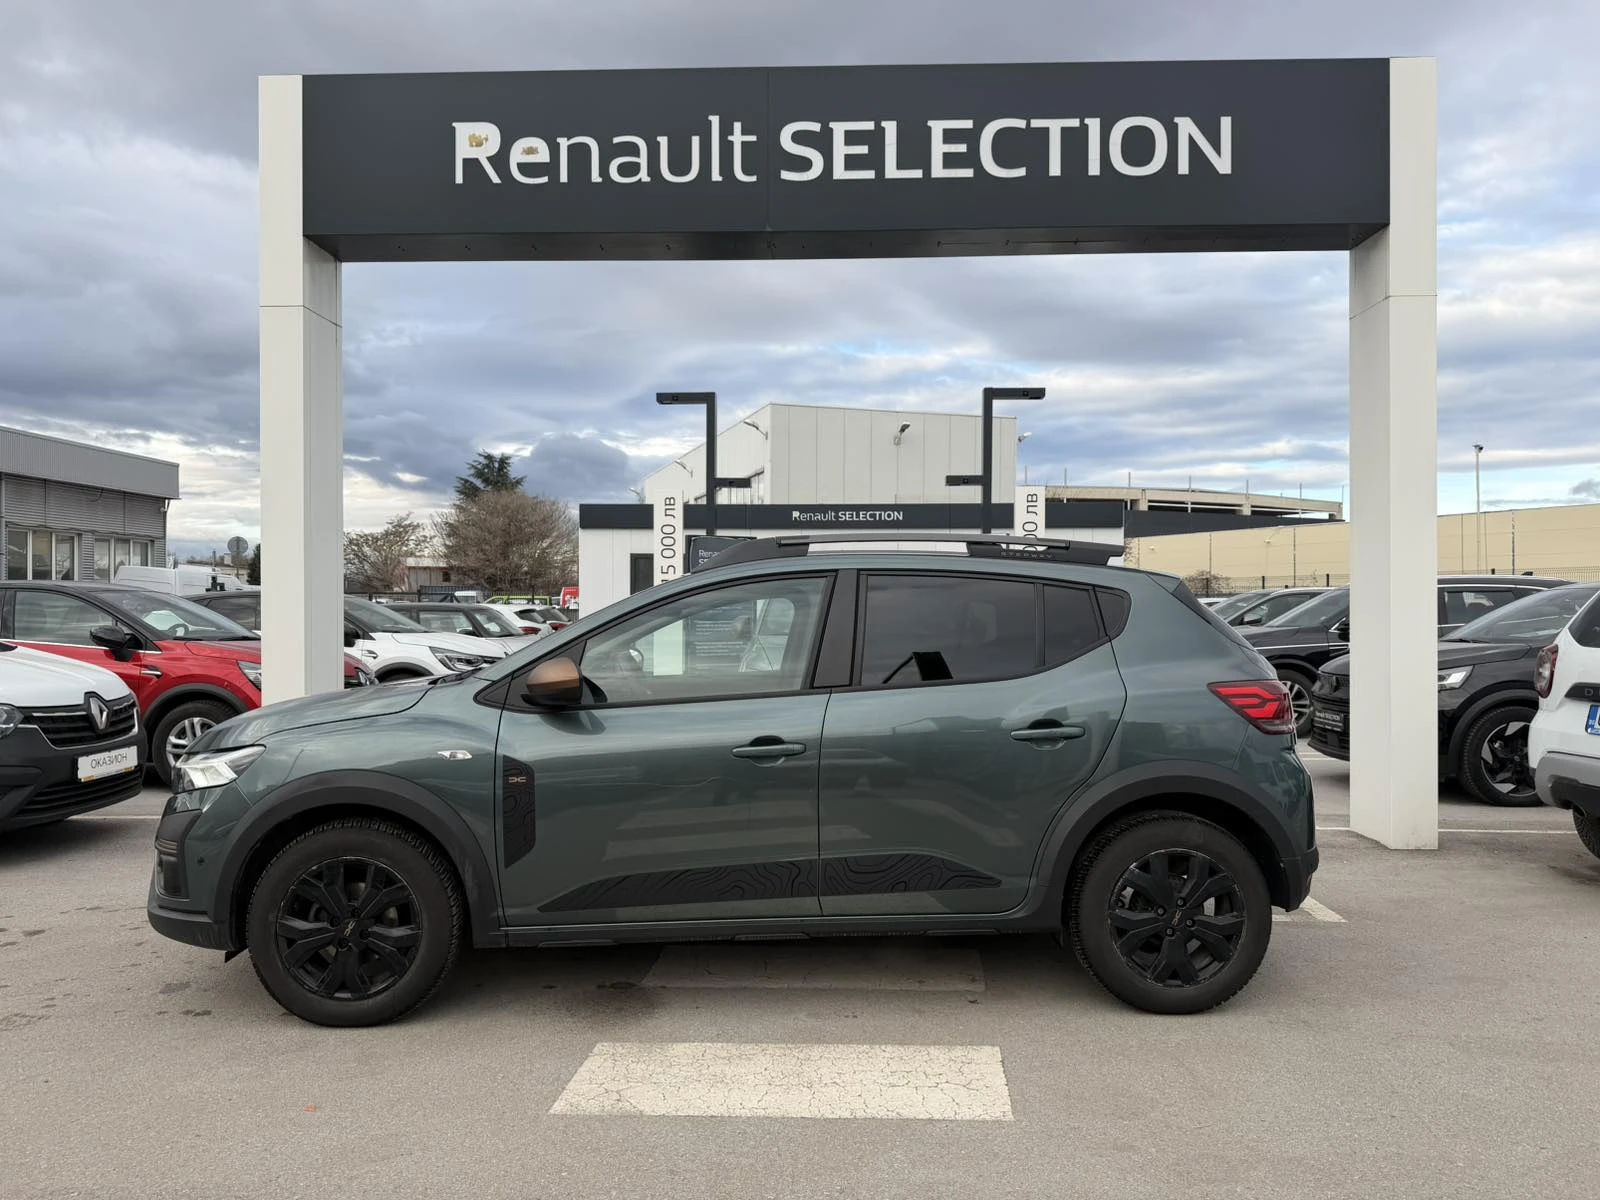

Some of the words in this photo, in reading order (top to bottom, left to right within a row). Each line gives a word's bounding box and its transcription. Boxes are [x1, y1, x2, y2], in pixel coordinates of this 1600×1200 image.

[452, 115, 757, 184] Renault
[779, 116, 1232, 181] SELECTION
[792, 510, 837, 521] Renault
[838, 511, 903, 521] SELECTION
[661, 524, 676, 559] 000
[90, 752, 128, 769] ОКАЗИОН
